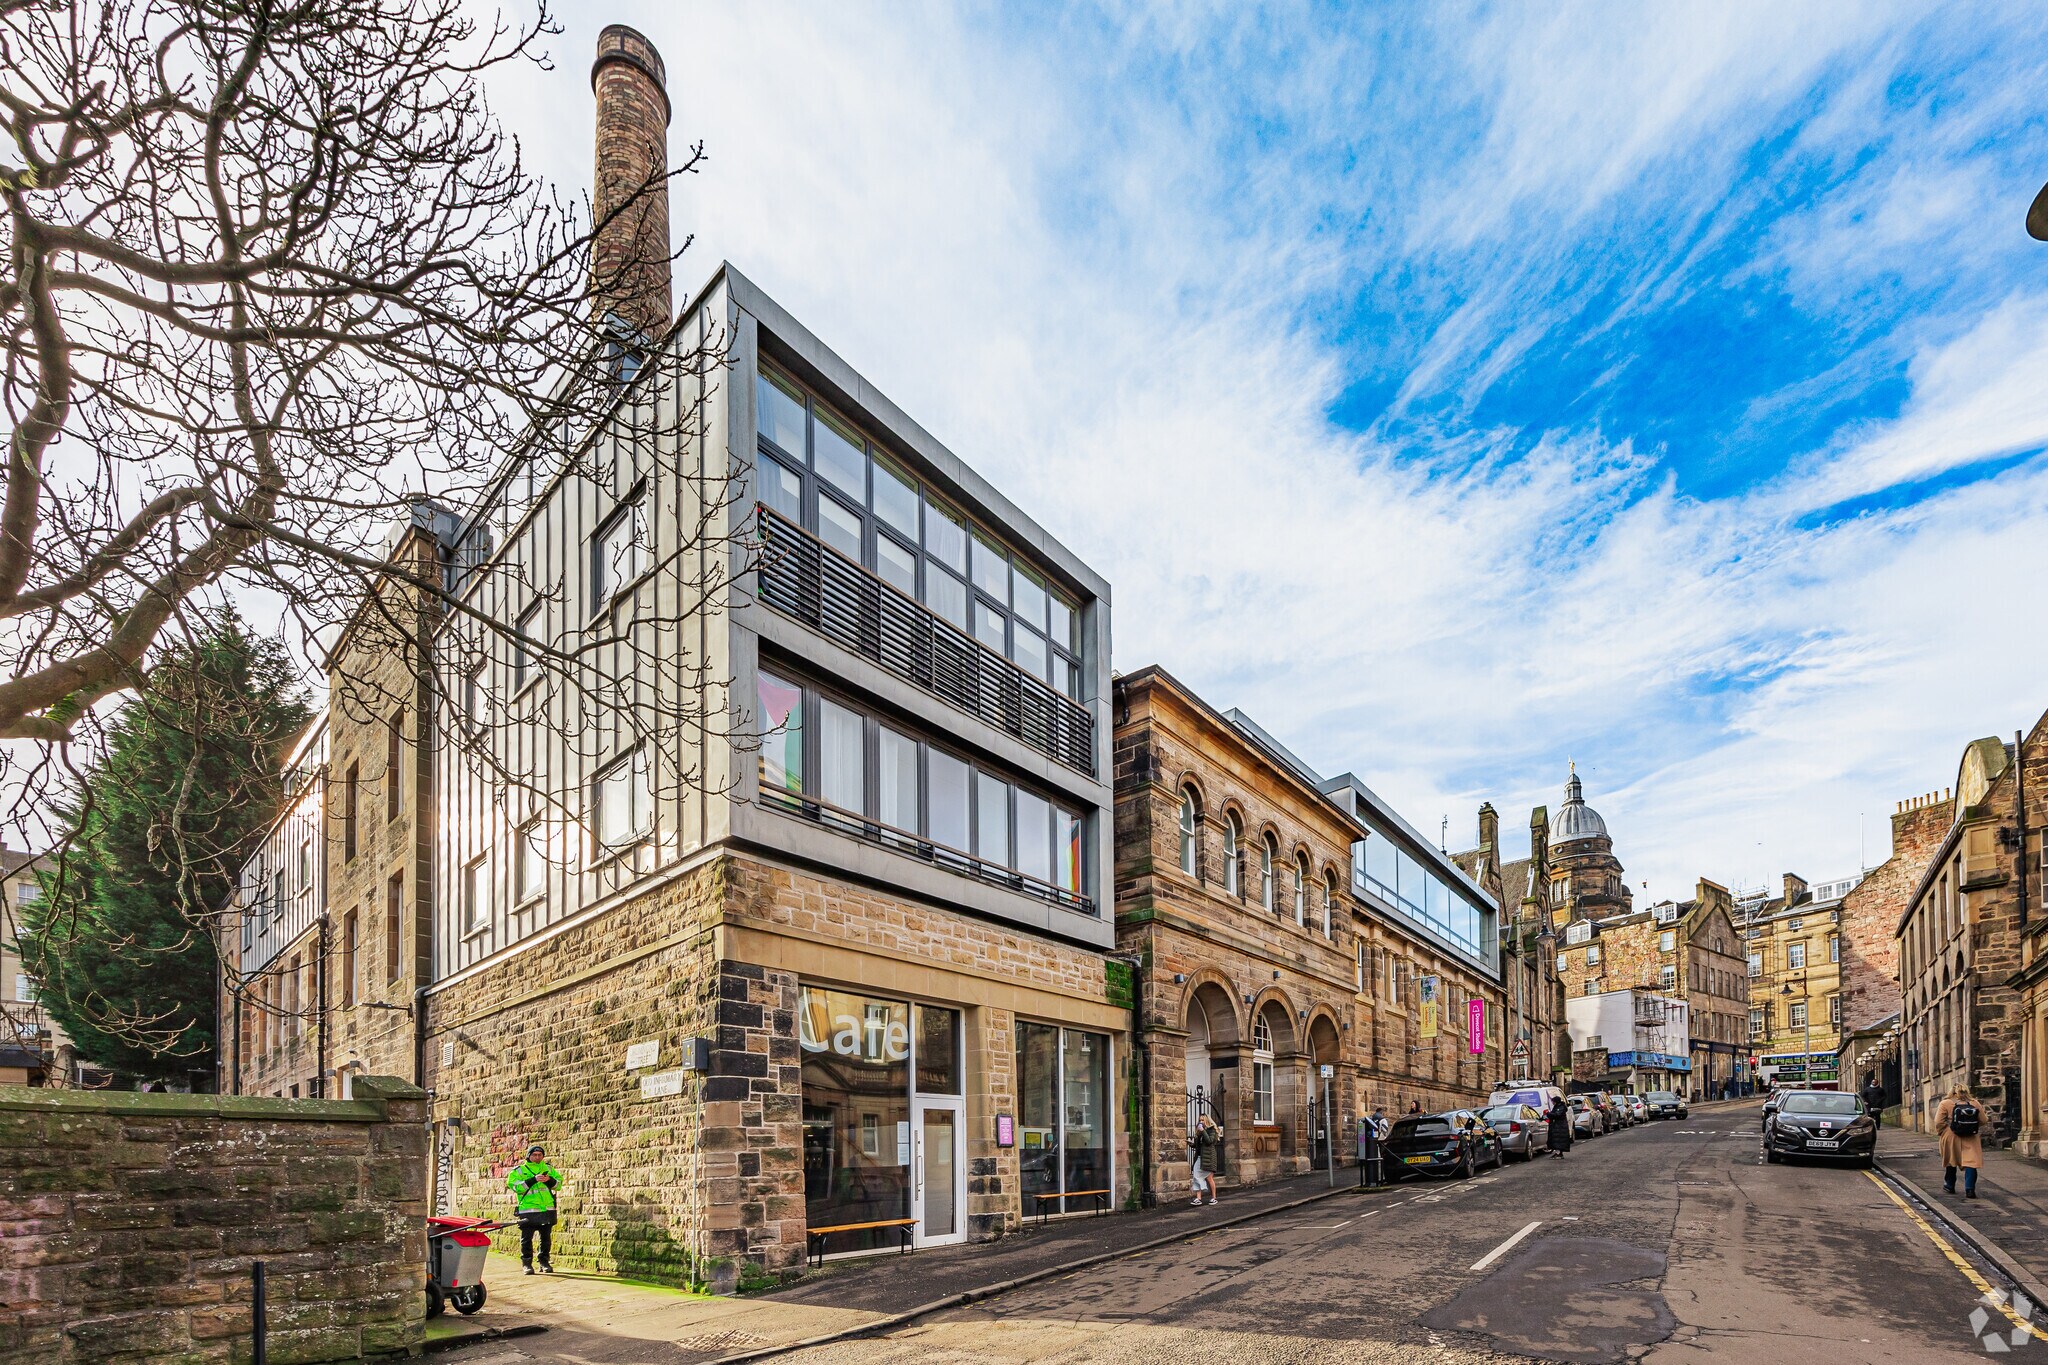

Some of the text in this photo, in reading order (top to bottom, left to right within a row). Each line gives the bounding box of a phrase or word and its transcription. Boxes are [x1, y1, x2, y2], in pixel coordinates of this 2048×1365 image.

[798, 994, 910, 1060] Café
[643, 1072, 682, 1087] OLD INFIRMARY
[655, 1085, 668, 1095] LANE
